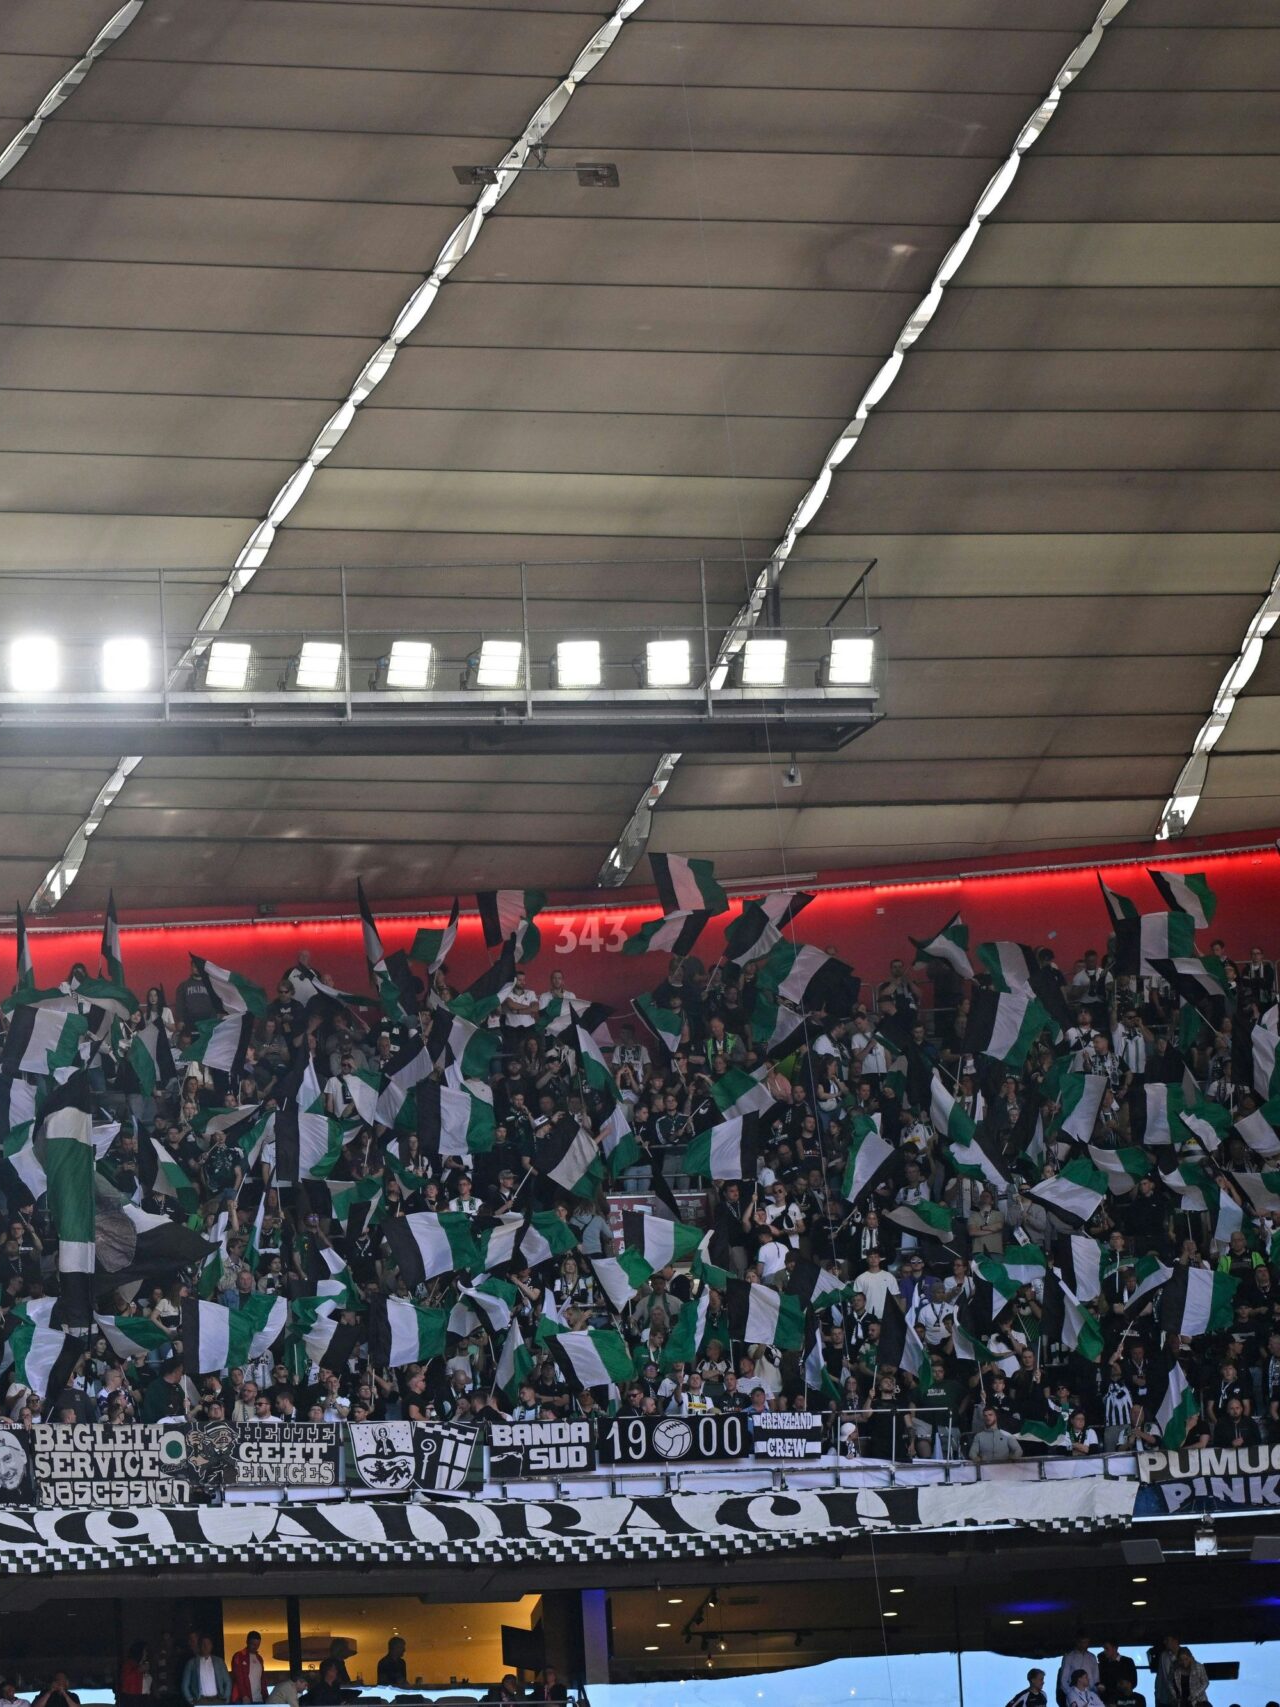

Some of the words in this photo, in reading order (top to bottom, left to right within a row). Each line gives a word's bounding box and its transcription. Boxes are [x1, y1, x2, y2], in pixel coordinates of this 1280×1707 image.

[554, 914, 628, 954] 343
[236, 1421, 336, 1445] HEUTE
[491, 1421, 590, 1447] BANDA
[760, 1412, 814, 1430] GRENZLAND
[33, 1424, 164, 1452] BEGLEIT
[606, 1419, 647, 1460] 19
[698, 1416, 742, 1456] 00
[766, 1437, 807, 1458] CREW
[34, 1451, 160, 1479] SERVICE
[239, 1442, 328, 1464] GEHT
[528, 1445, 588, 1470] SUD
[1138, 1444, 1280, 1483] PUMU
[236, 1461, 335, 1485] EINIGES
[39, 1478, 190, 1506] OBSESSION
